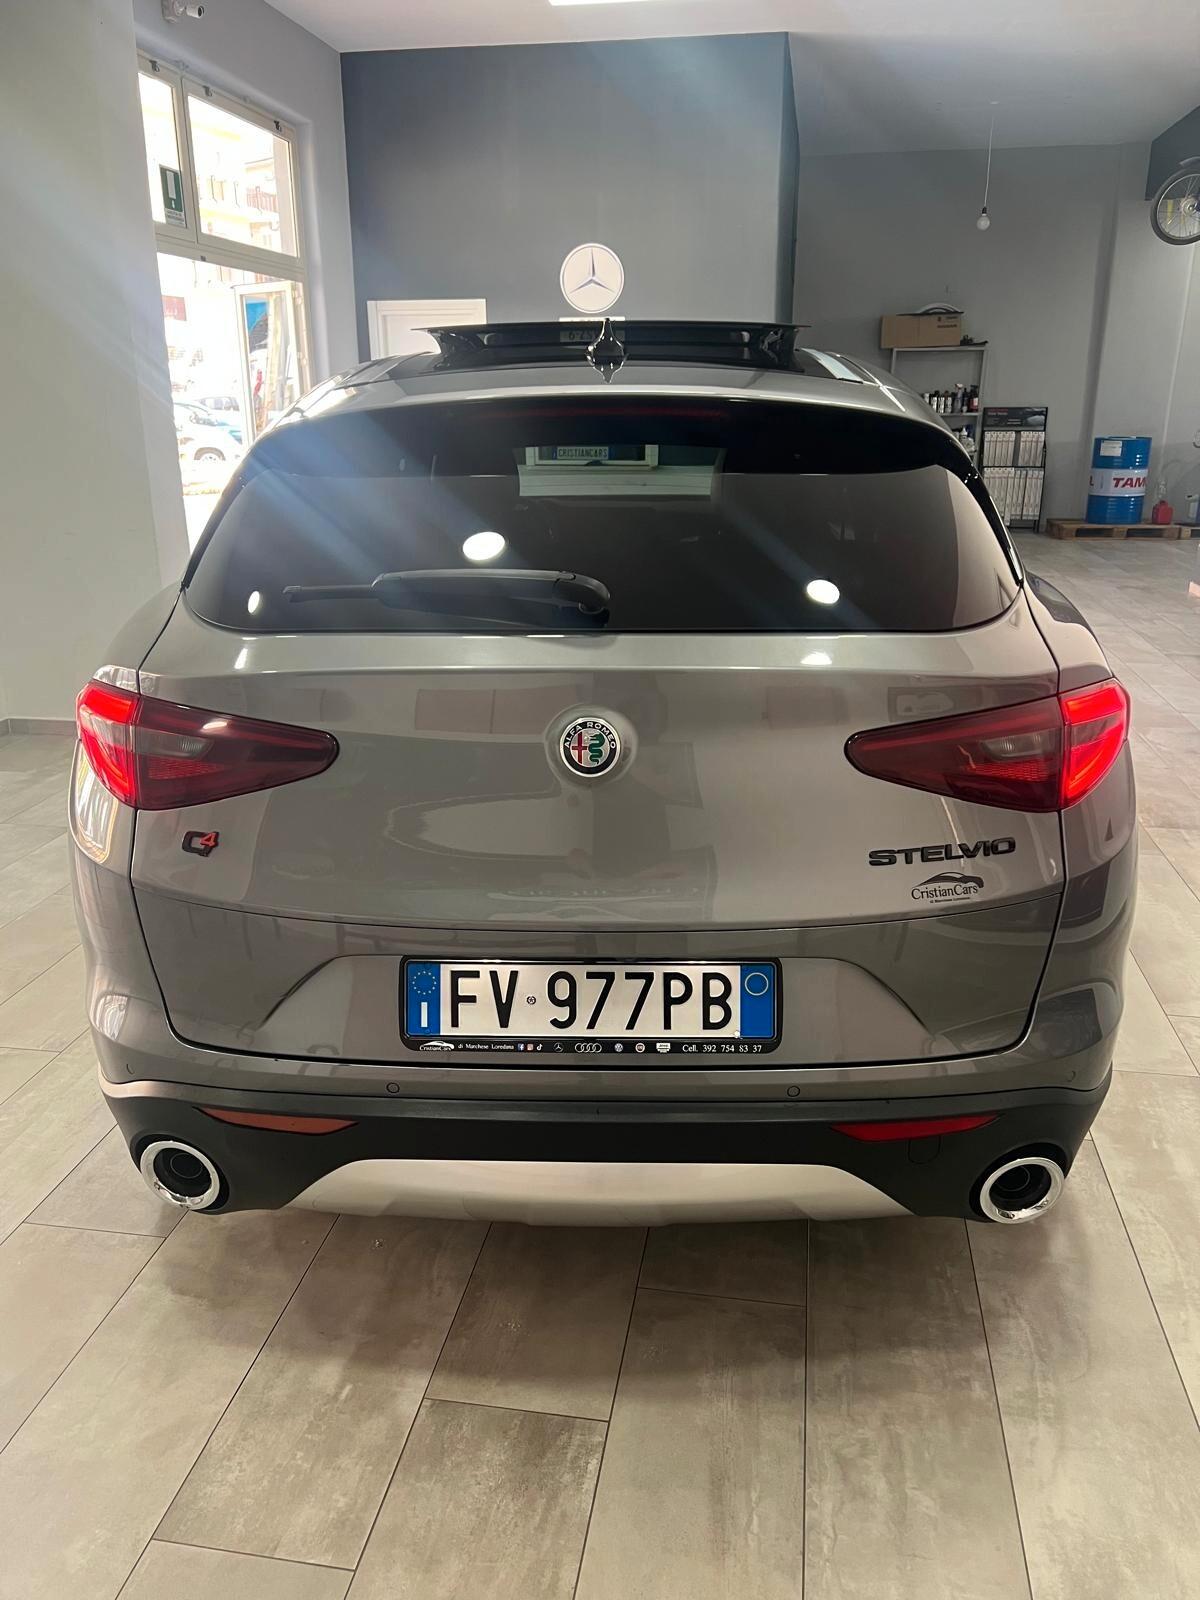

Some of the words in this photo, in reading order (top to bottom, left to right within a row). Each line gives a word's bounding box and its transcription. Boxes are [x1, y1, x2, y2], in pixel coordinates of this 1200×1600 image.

[564, 725, 582, 748] ALFA
[586, 721, 616, 749] ROMEO
[182, 831, 219, 857] Q4
[869, 837, 1016, 867] STELVIO
[911, 884, 979, 901] CristianCars
[420, 1001, 429, 1028] I
[450, 970, 519, 1028] FV
[547, 970, 733, 1030] 977PB
[682, 1044, 699, 1053] Cell.
[702, 1045, 717, 1053] 392
[721, 1045, 735, 1053] 754
[738, 1045, 749, 1053] 83
[752, 1045, 762, 1053] 37
